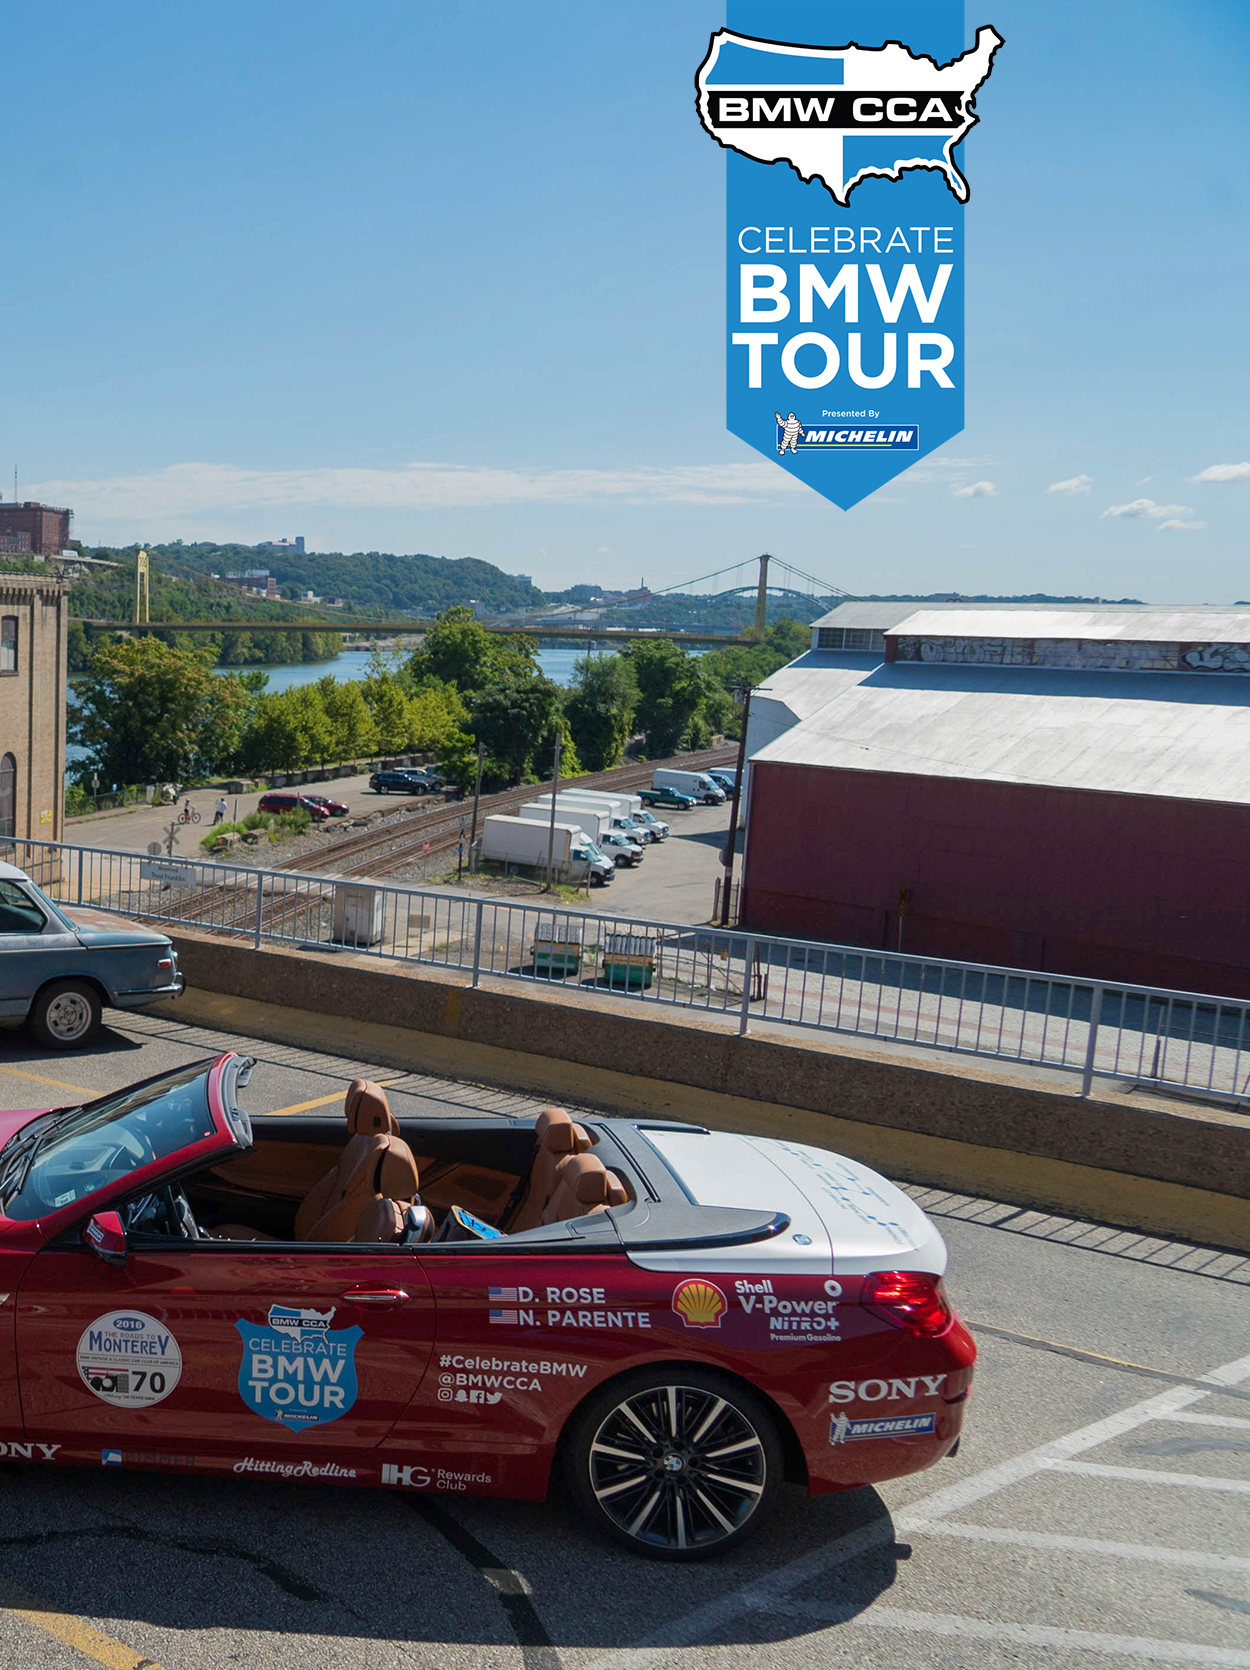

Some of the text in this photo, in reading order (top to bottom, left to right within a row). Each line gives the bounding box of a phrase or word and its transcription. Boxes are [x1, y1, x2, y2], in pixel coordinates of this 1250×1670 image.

[518, 1286, 606, 1304] D. ROSE
[734, 1280, 773, 1294] Shell
[738, 1296, 838, 1315] V-Power
[116, 1319, 143, 1329] 2016
[271, 1317, 326, 1328] BMW CCA
[519, 1310, 652, 1329] N. PARENTE
[89, 1330, 170, 1356] MONTEREY
[120, 1332, 144, 1340] ROADS
[770, 1333, 841, 1342] Premium Gasoline
[249, 1338, 347, 1356] CELEBRATE
[251, 1353, 346, 1384] BMW
[439, 1355, 588, 1378] #CelebrateBMW
[132, 1370, 166, 1394] 70
[438, 1372, 542, 1392] @BMWCCA
[829, 1374, 948, 1404] SONY
[248, 1380, 346, 1409] TOUR
[851, 1416, 932, 1434] MICHELIN
[233, 1457, 357, 1478] HittingRedline
[381, 1463, 492, 1487] IHG Rewards
[436, 1480, 467, 1491] Club
